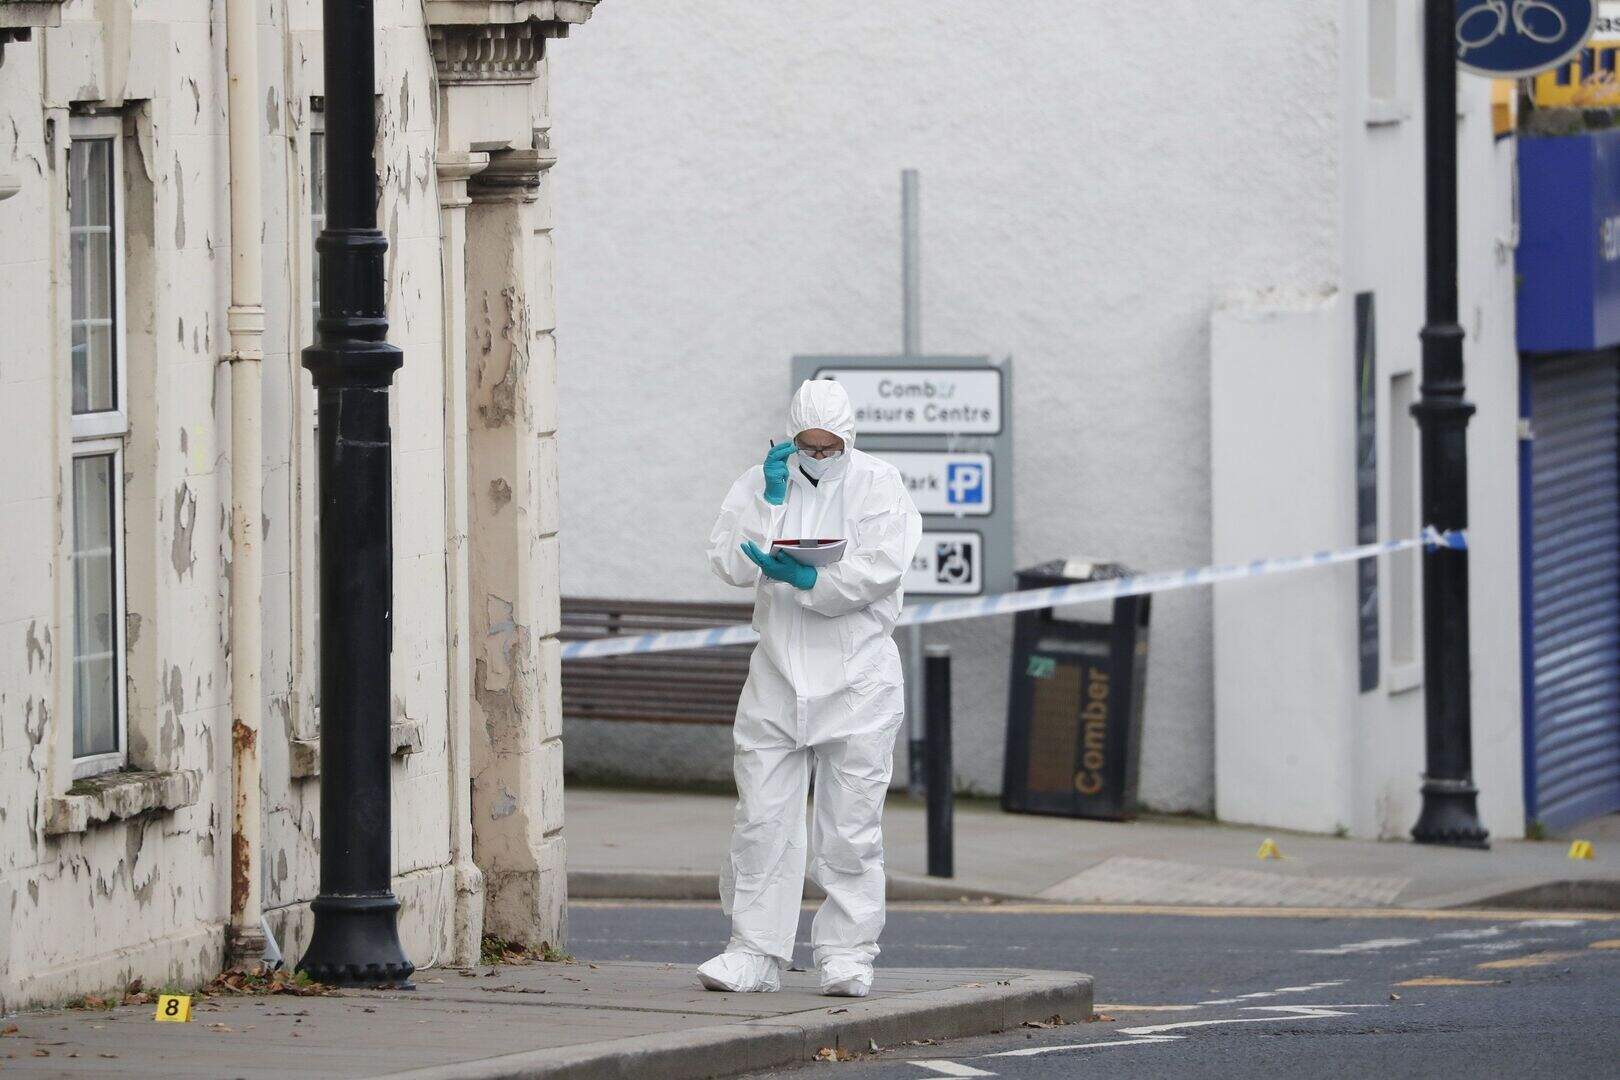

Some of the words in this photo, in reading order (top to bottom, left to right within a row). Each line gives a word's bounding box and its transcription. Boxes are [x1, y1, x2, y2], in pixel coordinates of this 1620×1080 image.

[856, 405, 915, 421] eisure
[923, 403, 991, 421] Centre
[1074, 666, 1110, 794] Comber
[165, 998, 179, 1016] 8
